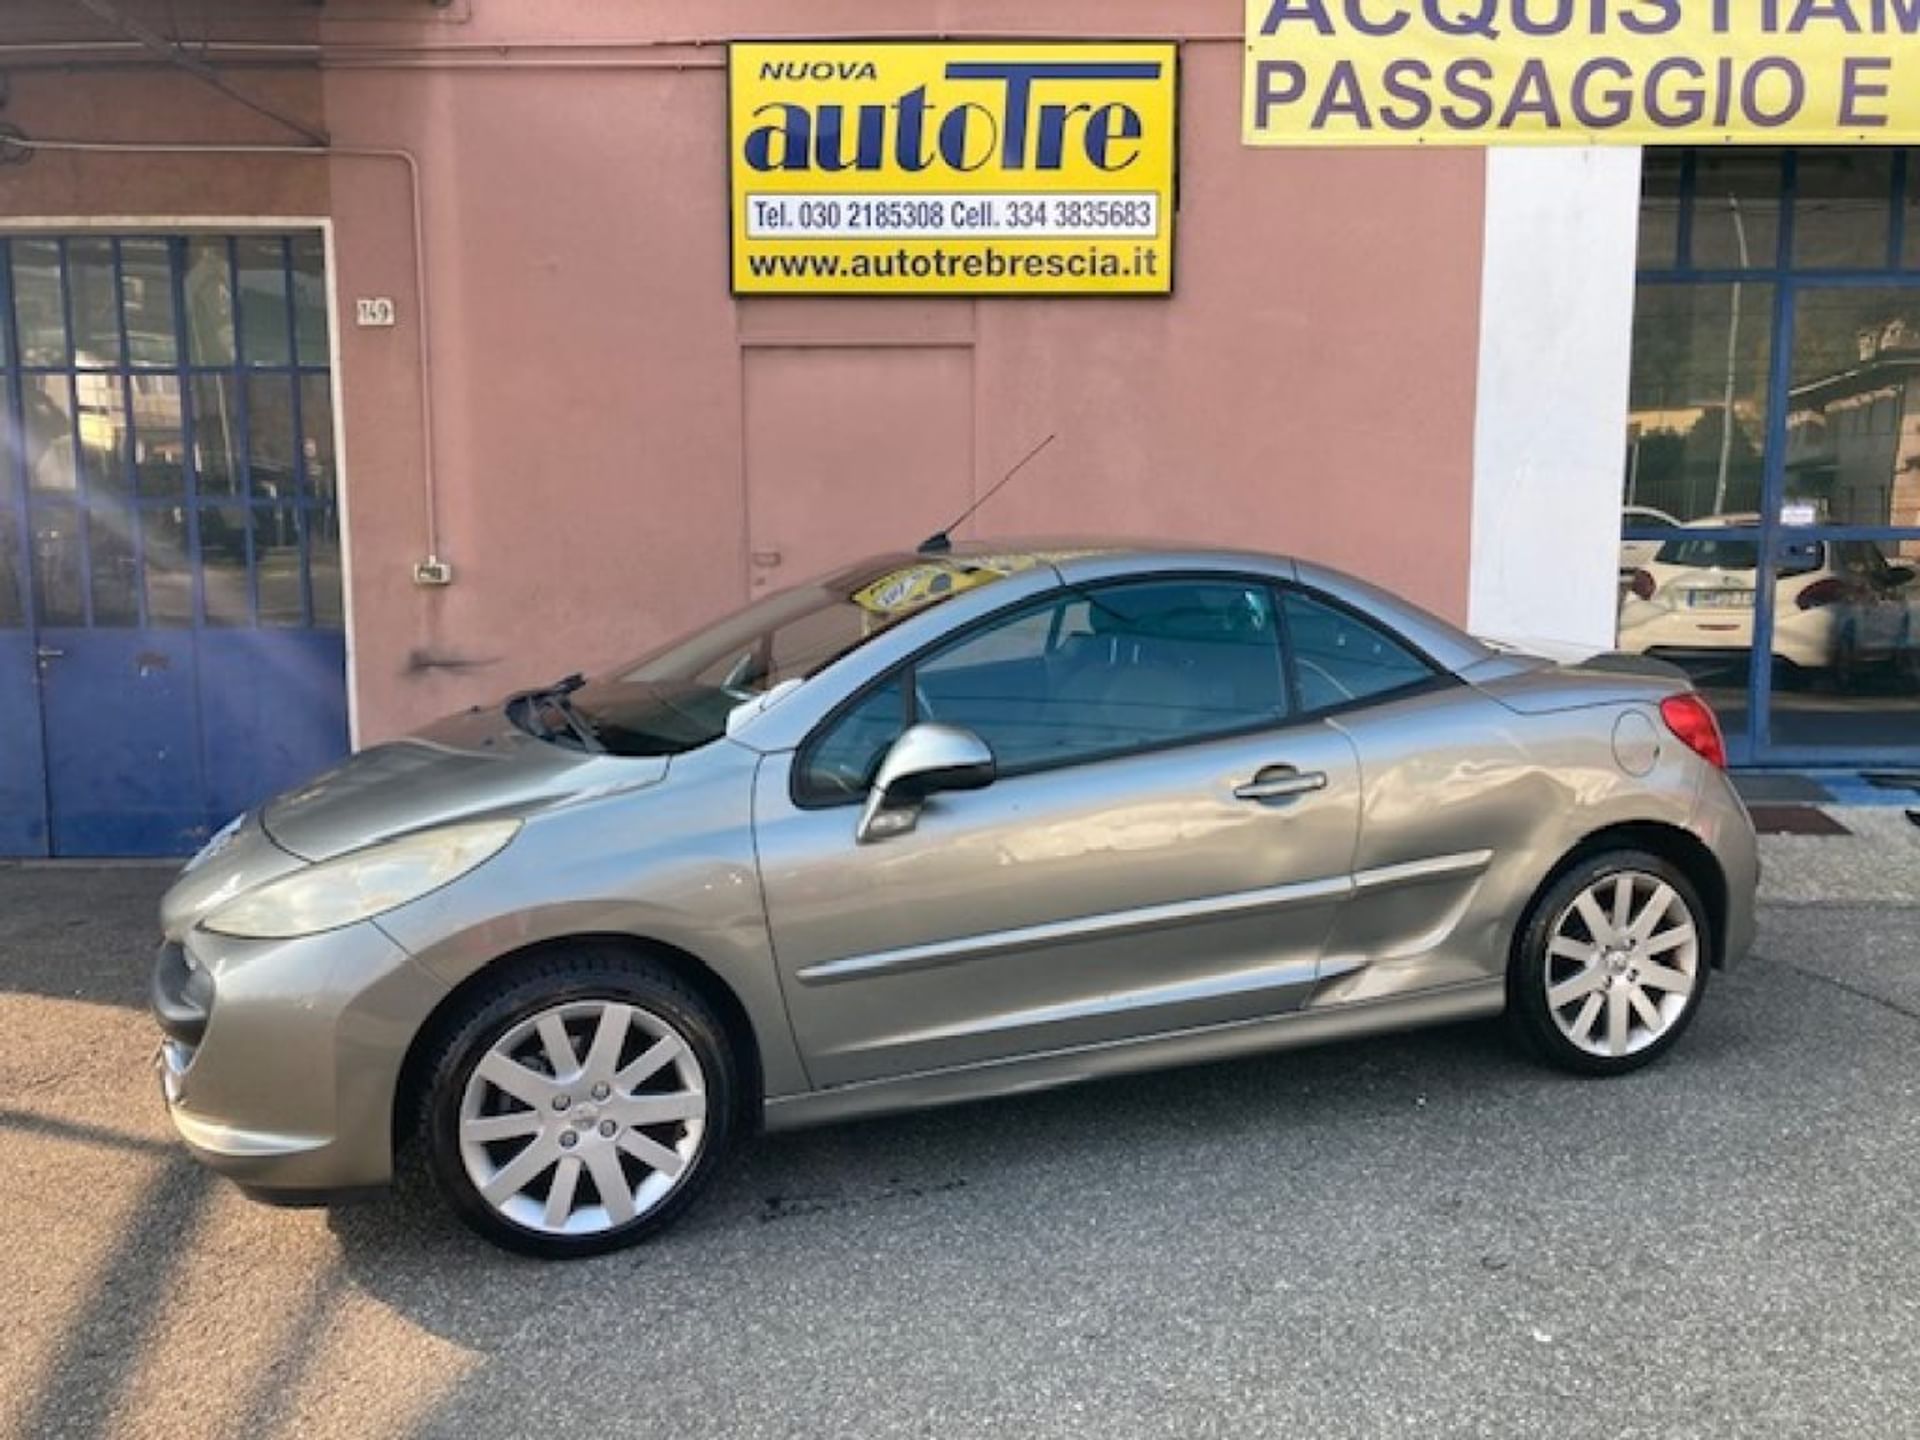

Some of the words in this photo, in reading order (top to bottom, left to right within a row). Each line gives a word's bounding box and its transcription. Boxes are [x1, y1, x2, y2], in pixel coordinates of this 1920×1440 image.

[759, 61, 878, 81] NUOVA
[1254, 56, 1805, 130] PASSAGGIO
[1837, 57, 1891, 127] E
[743, 61, 1162, 172] autoTre
[754, 201, 793, 228] Tel.
[801, 201, 841, 228] 030
[848, 201, 944, 228] 2185308
[951, 201, 1000, 228] Cell.
[1006, 201, 1047, 228] 334
[1054, 201, 1151, 228] 3835683
[748, 246, 1157, 278] www.autotrebrescia.it
